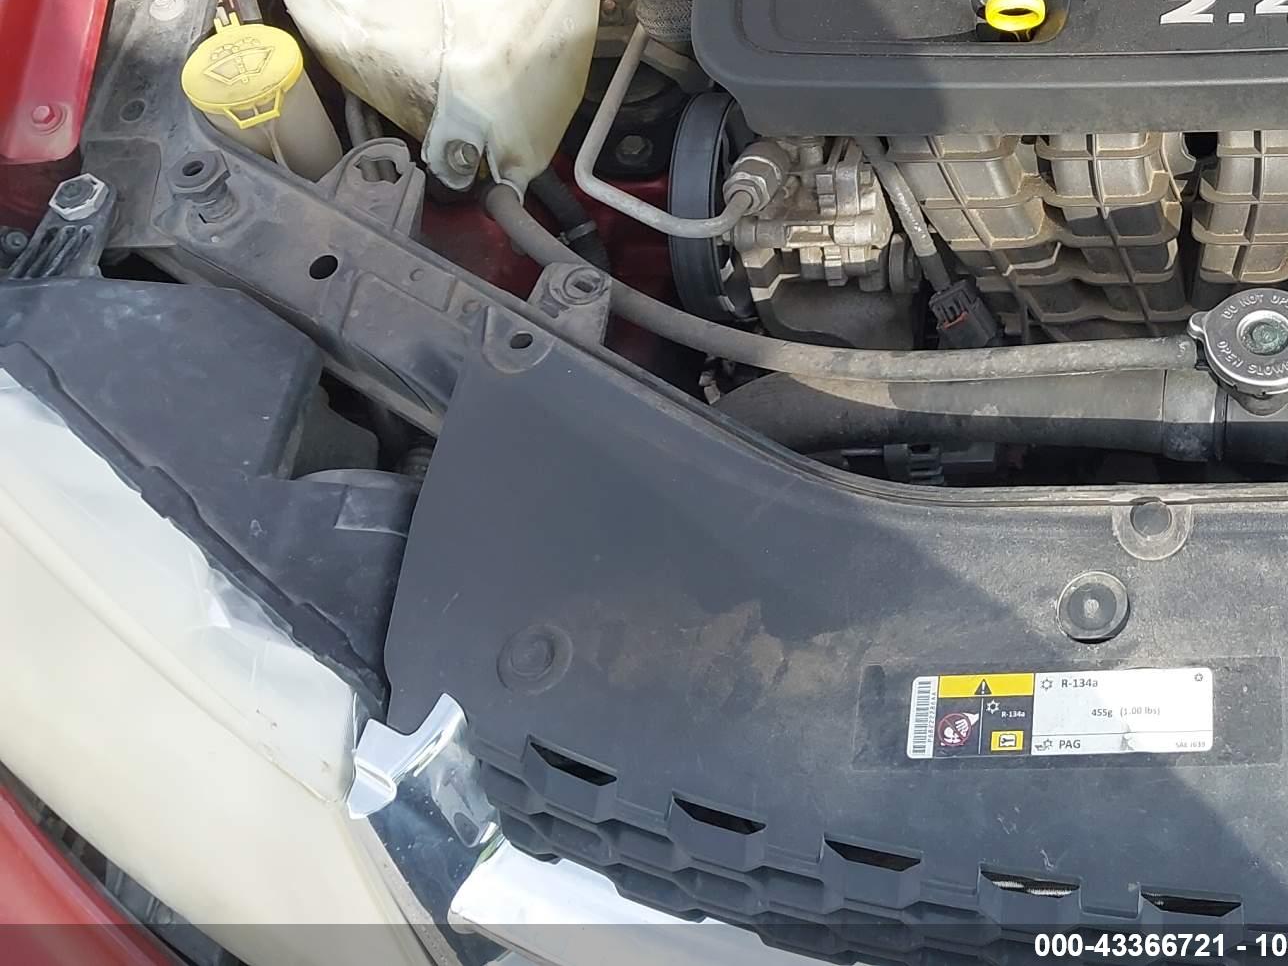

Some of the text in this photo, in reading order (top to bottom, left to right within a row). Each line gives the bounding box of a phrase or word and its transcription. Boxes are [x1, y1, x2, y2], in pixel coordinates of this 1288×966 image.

[1239, 294, 1264, 307] NOT
[1216, 340, 1244, 368] OPEN
[1060, 678, 1098, 689] R-134a
[1001, 710, 1026, 718] R-134a
[1091, 708, 1113, 718] 455g
[1144, 705, 1161, 716] lbs)
[1058, 739, 1081, 750] PAG
